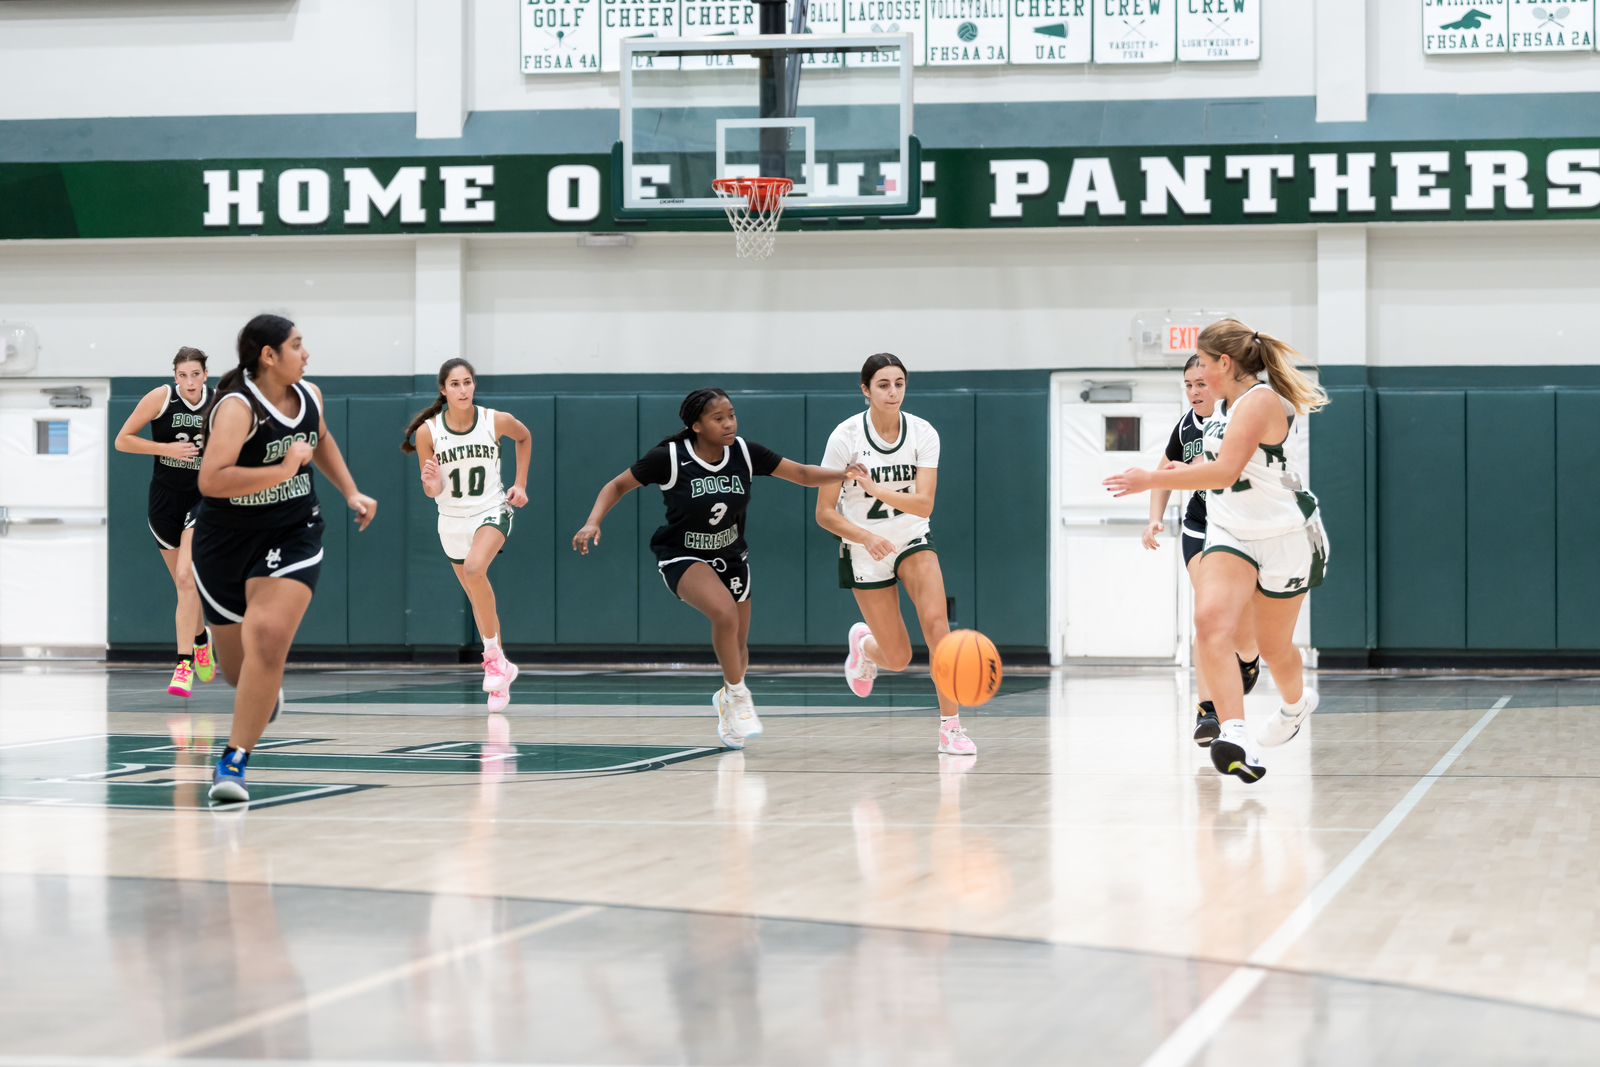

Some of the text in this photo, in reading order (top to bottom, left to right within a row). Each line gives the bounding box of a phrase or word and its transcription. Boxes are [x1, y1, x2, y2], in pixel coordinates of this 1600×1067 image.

[685, 5, 754, 26] CHEER
[848, 1, 921, 21] LACROSSE
[930, 0, 1004, 19] VOLLEYBALL
[1015, 0, 1085, 17] CHEER
[1104, 0, 1161, 16] CREW
[1188, 0, 1246, 14] CREW
[533, 8, 585, 28] GOLF
[606, 7, 674, 27] CHEER
[1108, 41, 1146, 50] VARSITY
[1426, 33, 1505, 49] FHSAA 2A
[1512, 31, 1591, 47] FHSAA 2A
[523, 54, 597, 69] FHSAA 4A
[930, 45, 1005, 61] FHSAA 3A
[1035, 45, 1066, 60] UAC
[203, 164, 496, 227] HOME
[988, 148, 1600, 218] PANTHERS
[448, 465, 486, 499] 10
[690, 475, 745, 499] BOCA
[708, 502, 728, 526] 3
[684, 522, 739, 550] CHRISTIAN
